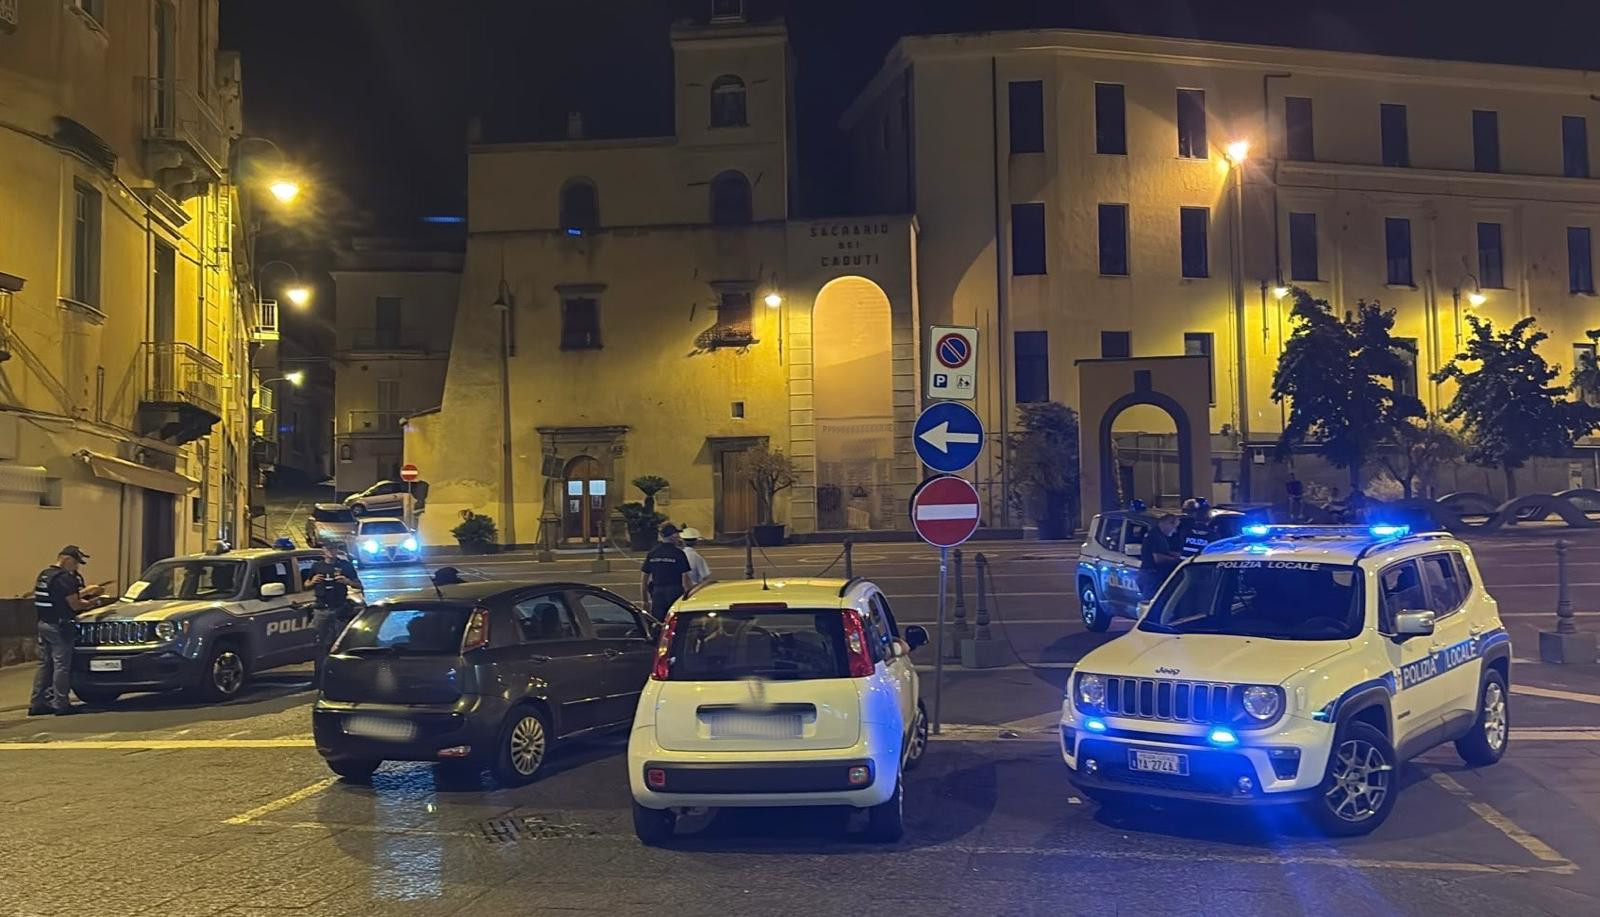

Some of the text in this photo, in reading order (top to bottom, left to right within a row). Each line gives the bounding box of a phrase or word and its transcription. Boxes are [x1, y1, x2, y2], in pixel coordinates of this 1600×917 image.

[810, 224, 889, 238] SACRARIO
[821, 254, 879, 267] CADUTI
[936, 375, 946, 387] P
[1216, 561, 1320, 571] POLIZIA LOCALE
[1403, 641, 1478, 687] POLIZIA LOCALE
[1155, 666, 1181, 676] Jeep
